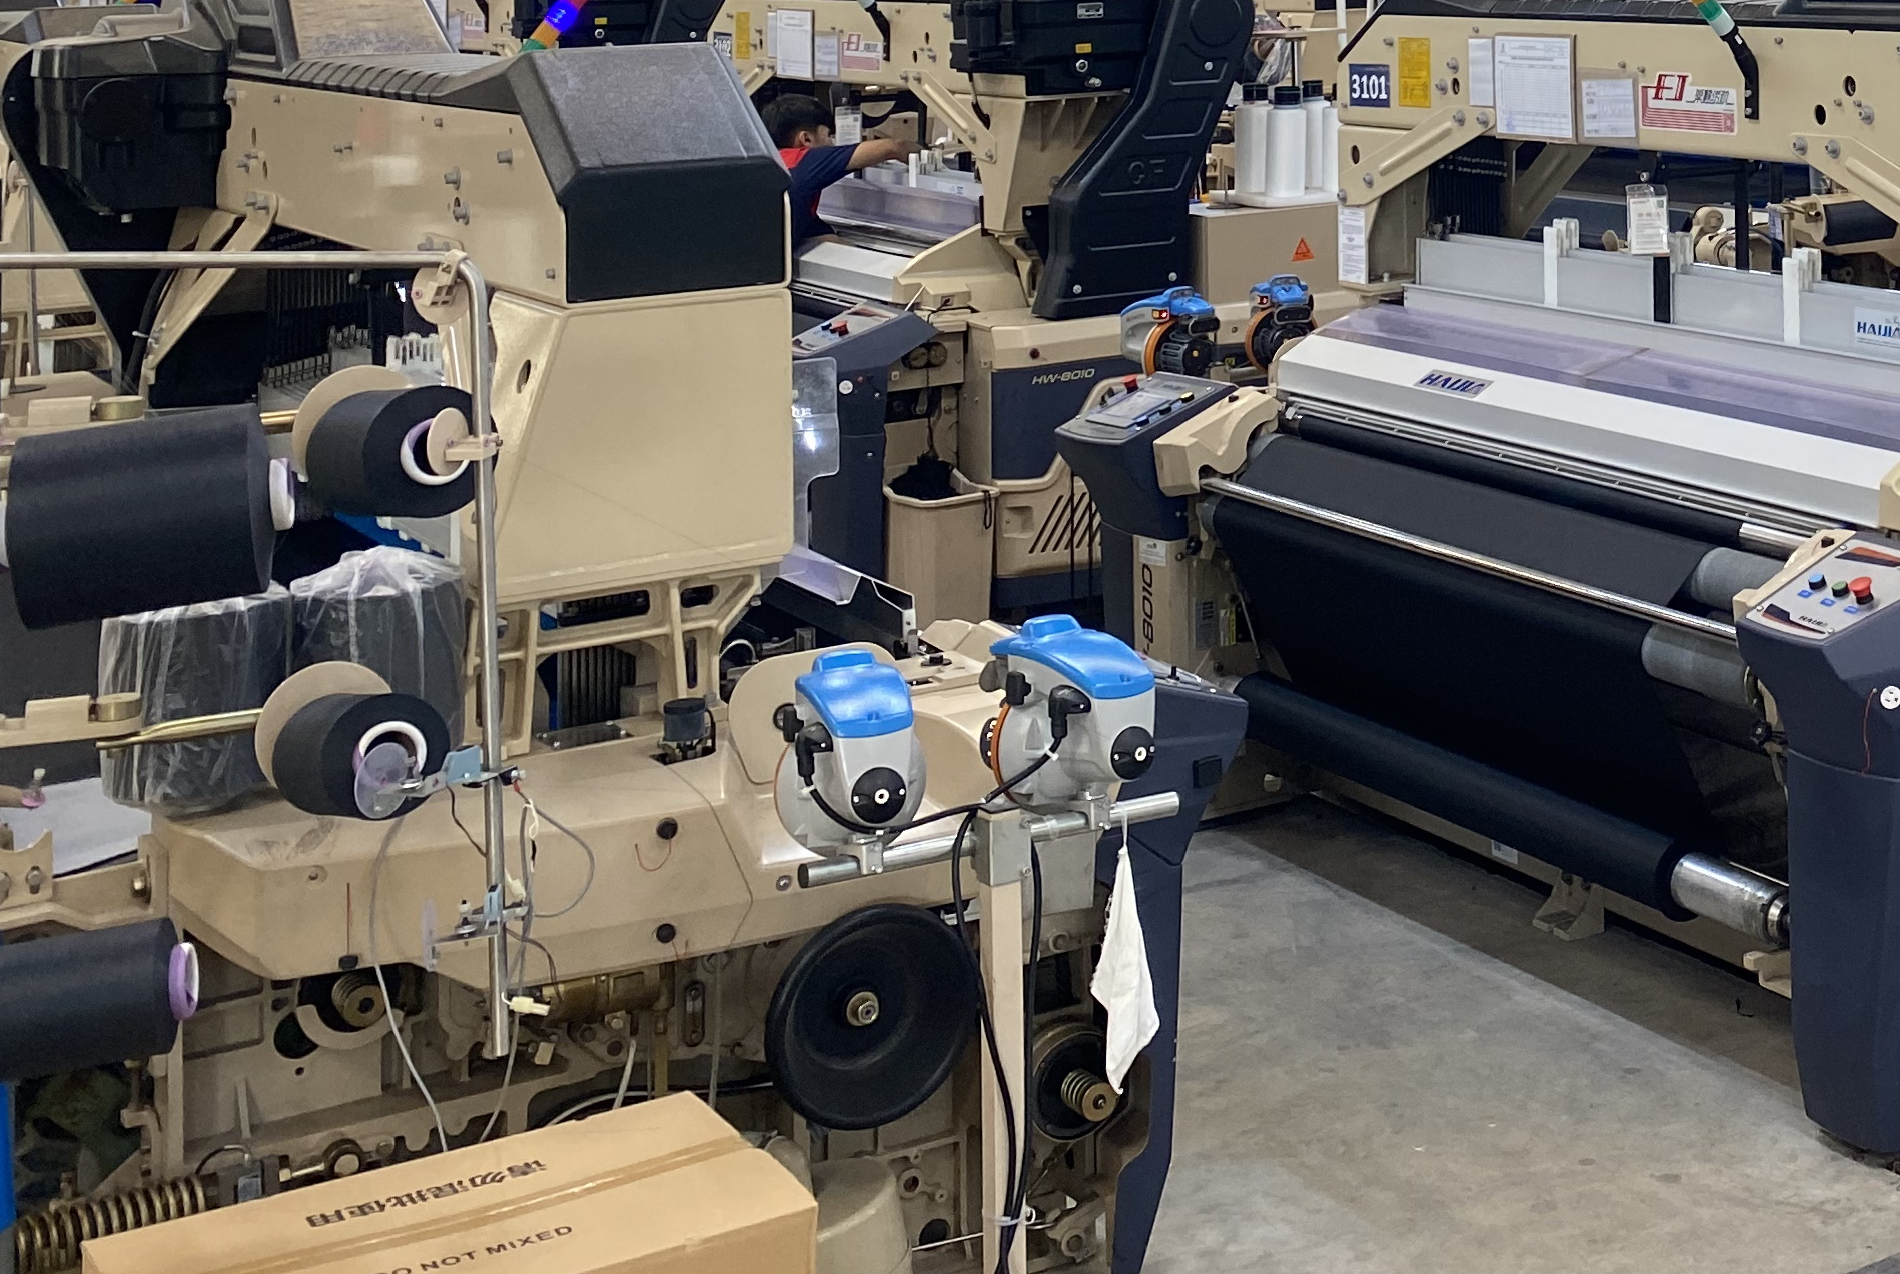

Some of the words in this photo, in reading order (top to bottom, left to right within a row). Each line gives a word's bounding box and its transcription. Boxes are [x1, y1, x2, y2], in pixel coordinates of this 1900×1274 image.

[1351, 74, 1388, 100] 3101
[1031, 368, 1095, 385] HW-8010
[1419, 373, 1486, 394] HAIJIA
[1142, 563, 1154, 654] -8010
[305, 1159, 547, 1228] 请勿混批使用
[420, 1250, 476, 1271] NOT
[486, 1226, 572, 1255] MIXED
